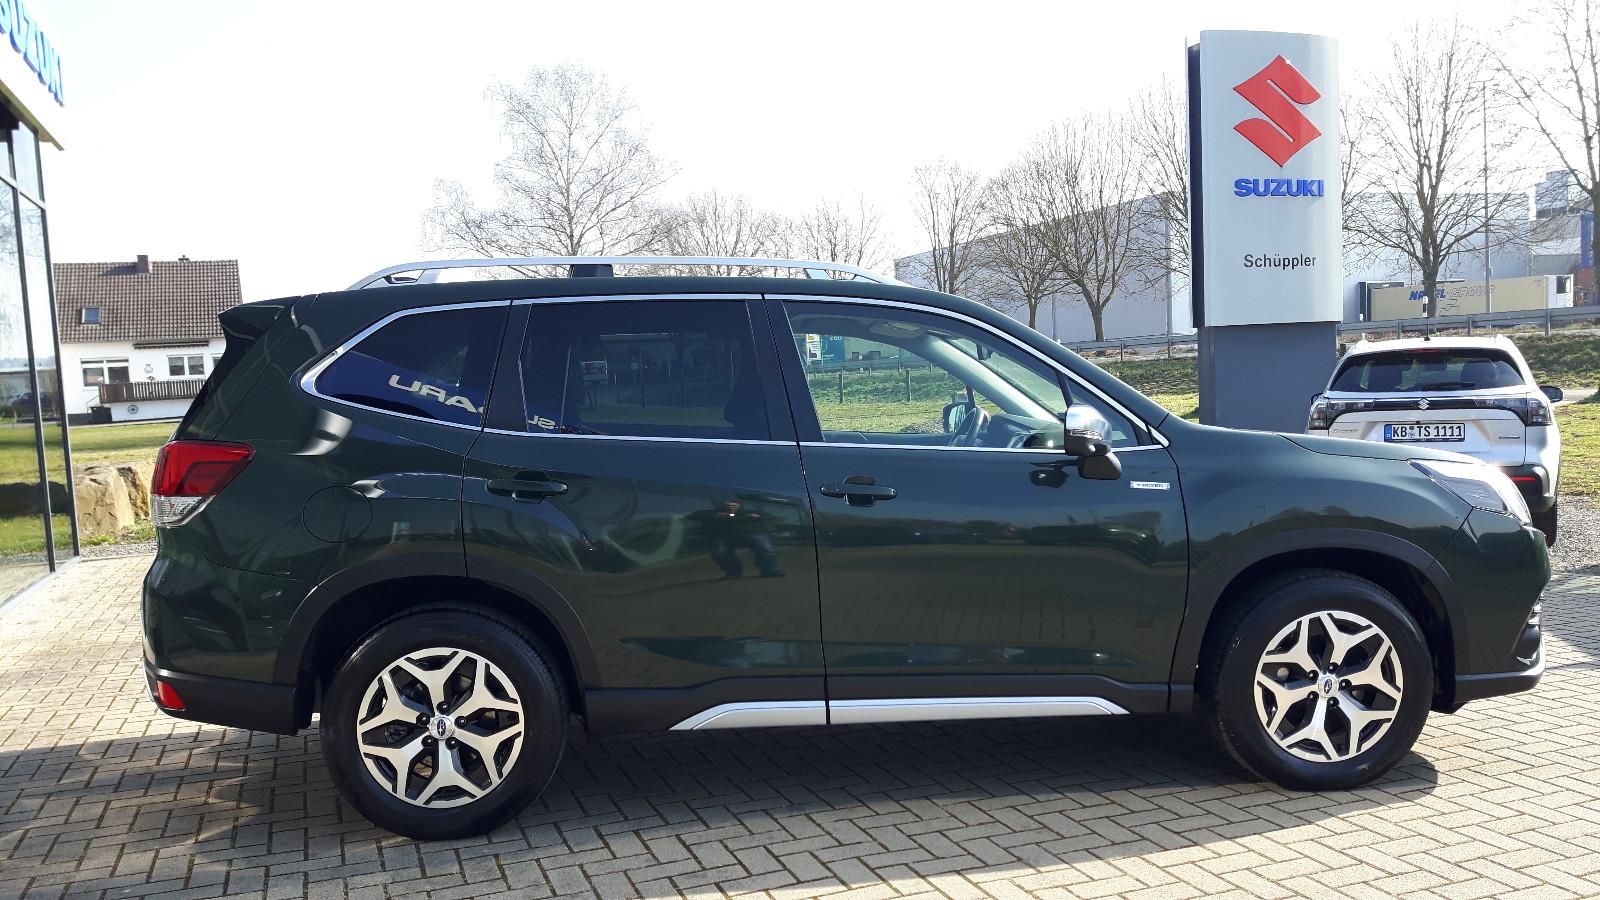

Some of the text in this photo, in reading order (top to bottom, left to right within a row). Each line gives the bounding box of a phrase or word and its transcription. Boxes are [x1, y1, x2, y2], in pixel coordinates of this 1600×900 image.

[1234, 178, 1325, 198] SUZUKI
[1243, 253, 1317, 271] Schüppler
[1392, 425, 1408, 438] KB
[1418, 425, 1431, 438] TS
[1433, 424, 1463, 438] 1111
